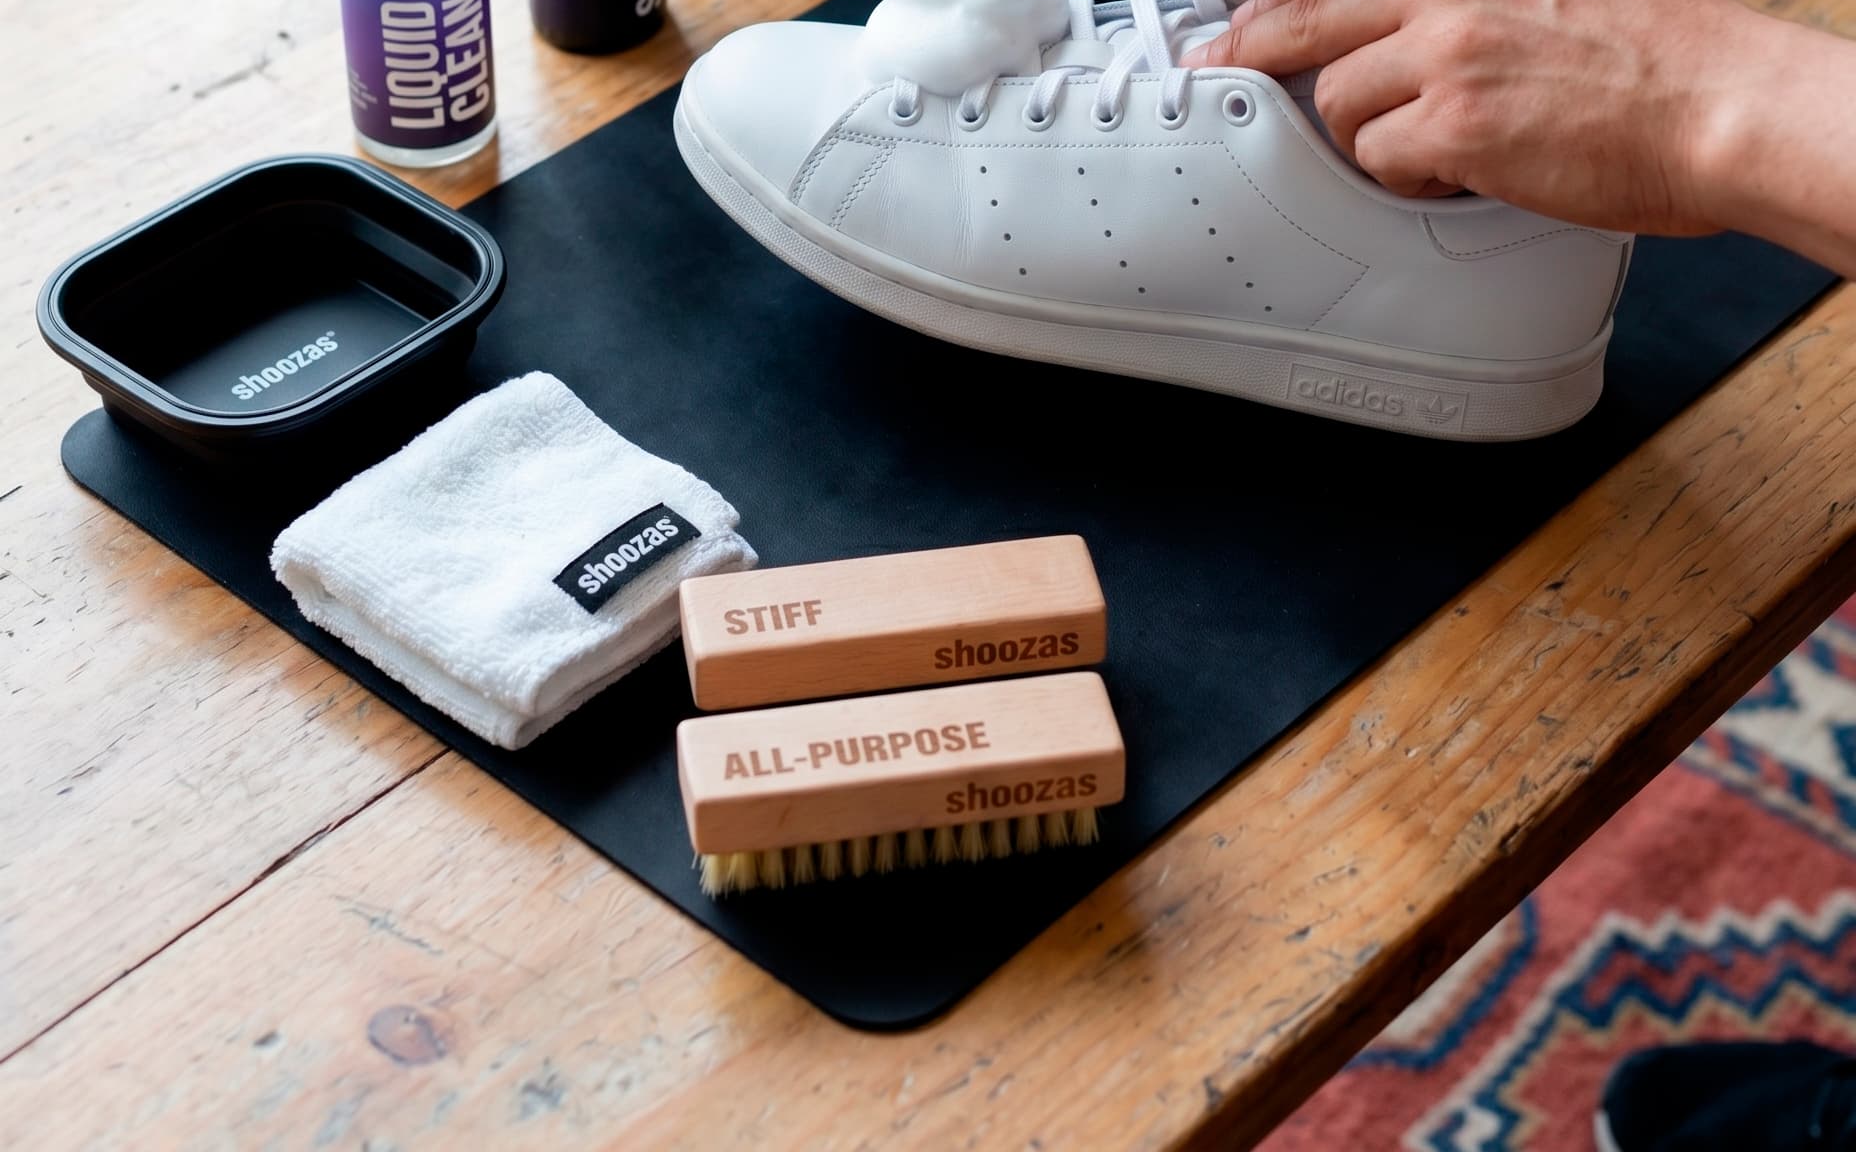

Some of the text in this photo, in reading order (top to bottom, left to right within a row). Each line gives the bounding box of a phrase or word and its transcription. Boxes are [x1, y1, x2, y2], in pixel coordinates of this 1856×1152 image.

[380, 1, 446, 129] LIQUID
[232, 333, 339, 401] shoozas
[1296, 378, 1404, 416] adidas
[578, 516, 680, 595] shoozas
[724, 599, 823, 635] STIFF
[934, 632, 1080, 670] shoozas
[723, 721, 991, 780] ALL-PURPOSE
[946, 773, 1098, 814] shoozas
